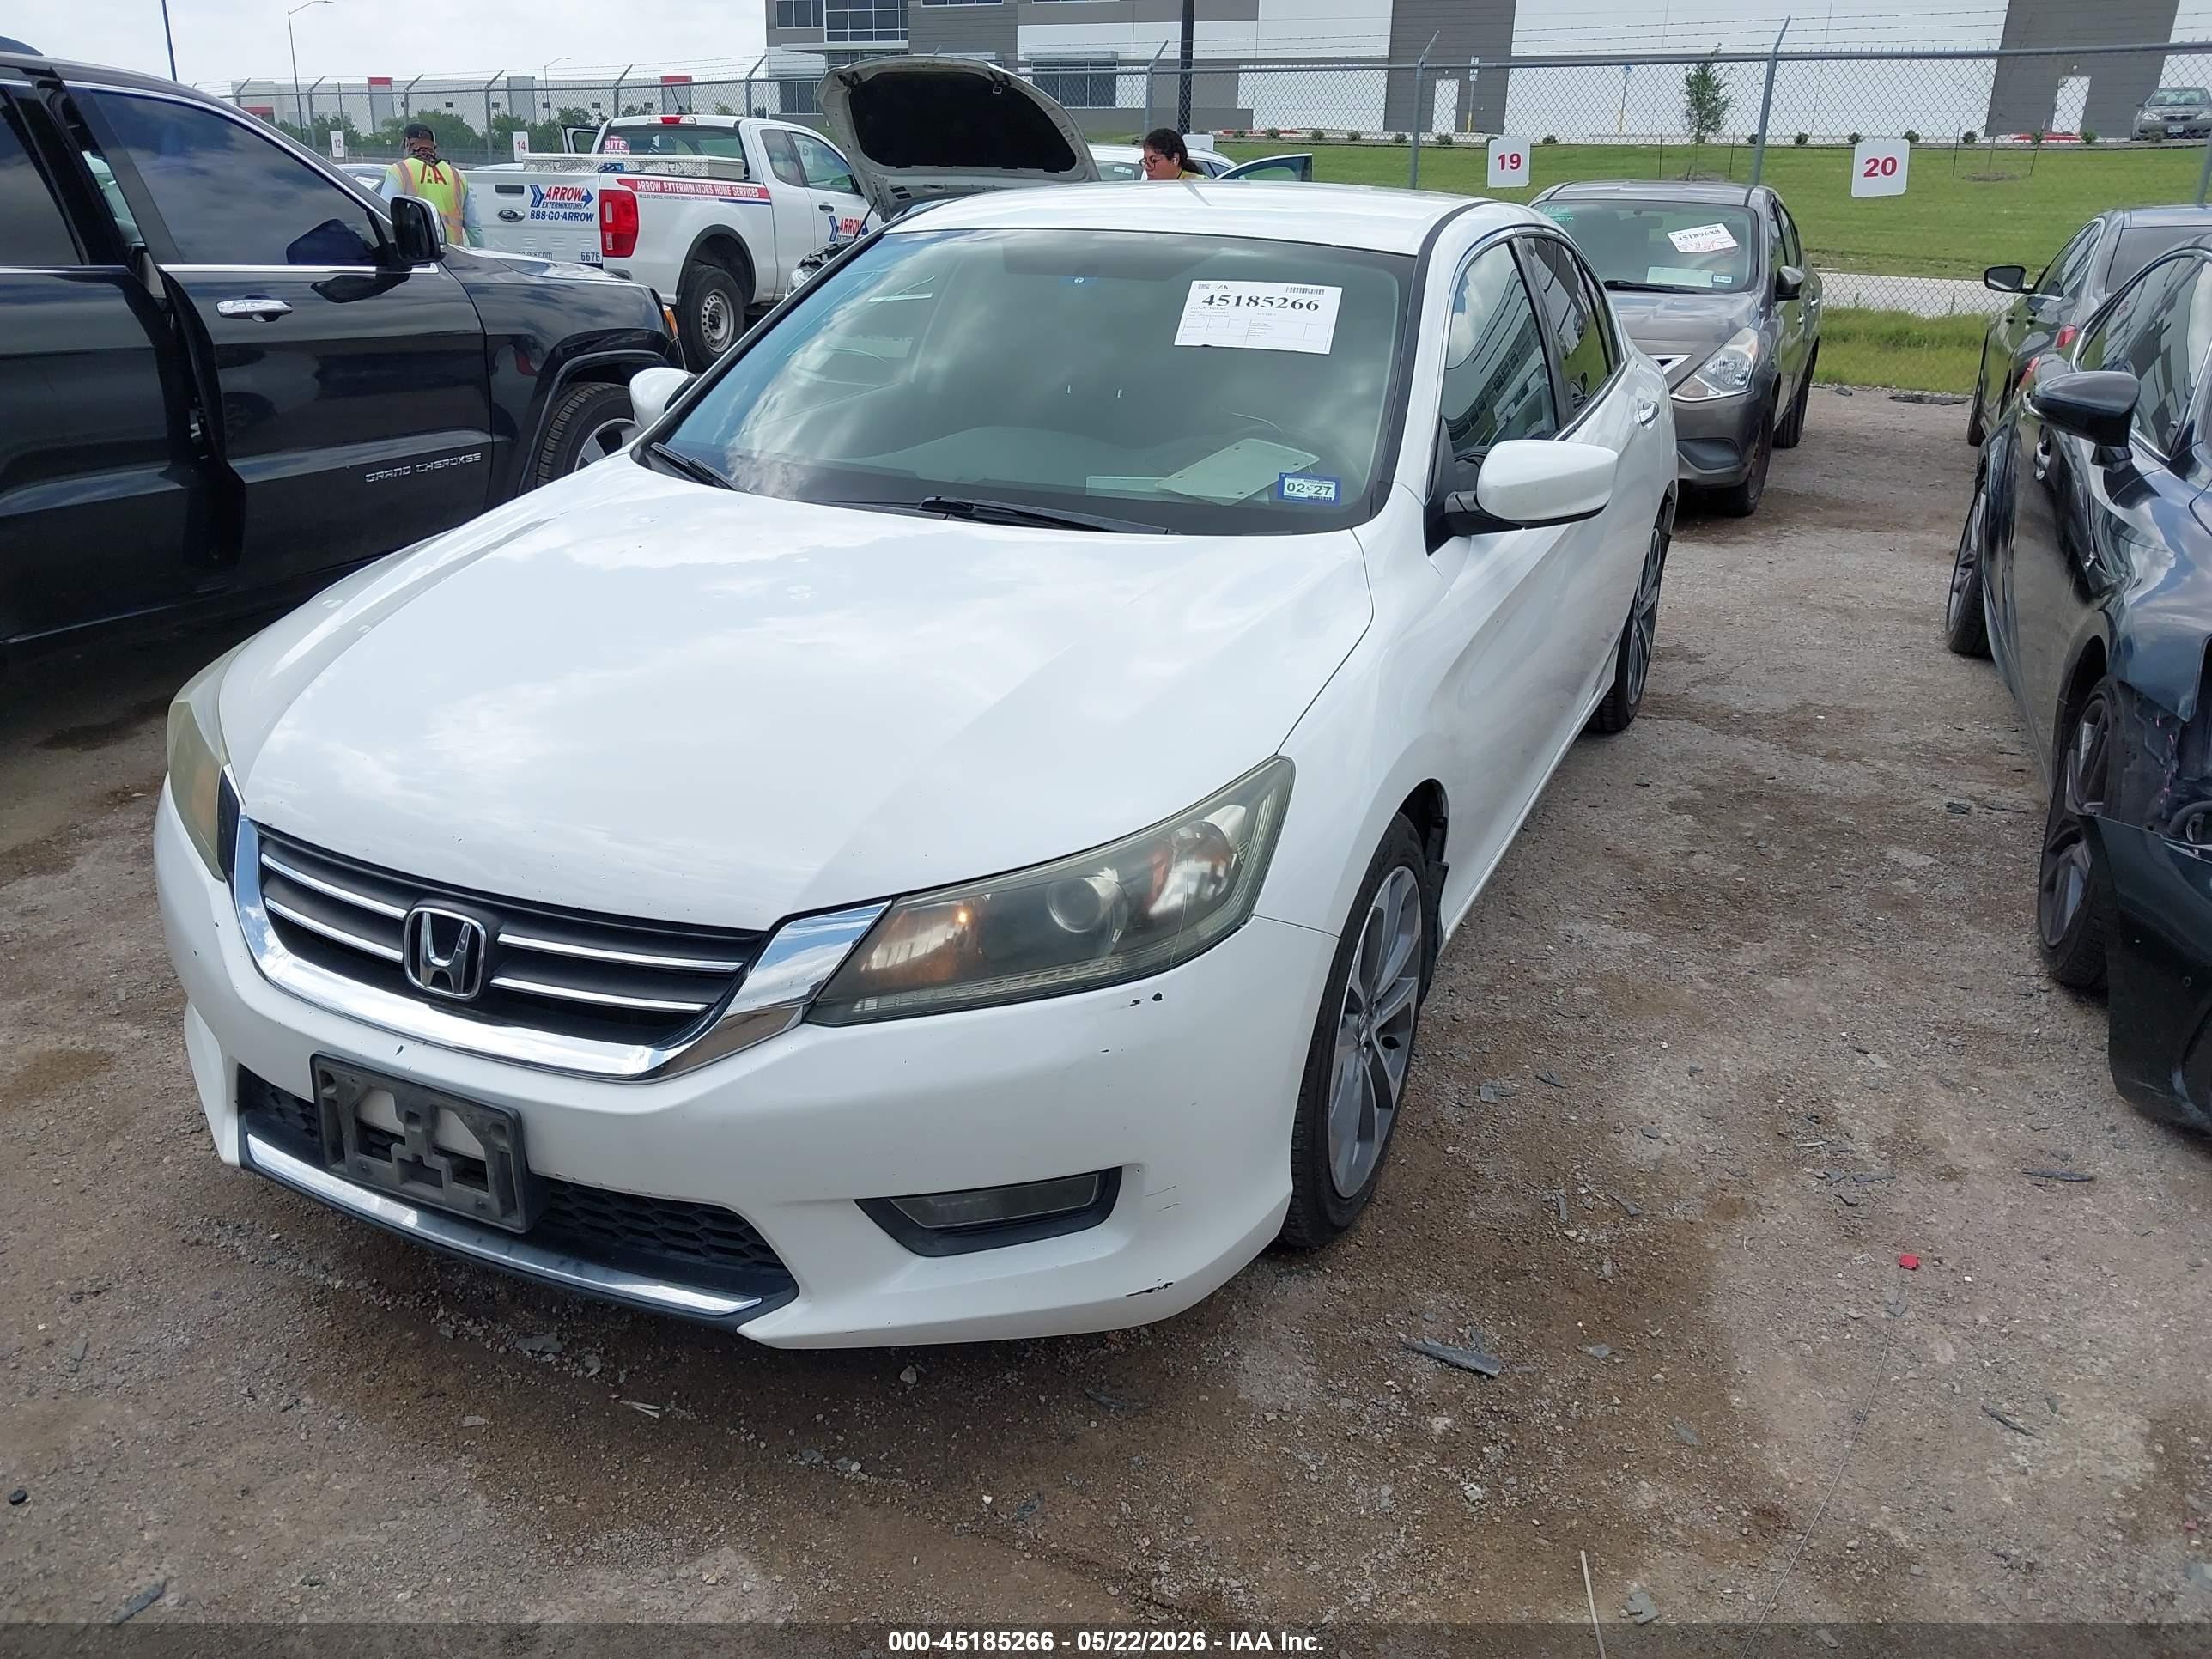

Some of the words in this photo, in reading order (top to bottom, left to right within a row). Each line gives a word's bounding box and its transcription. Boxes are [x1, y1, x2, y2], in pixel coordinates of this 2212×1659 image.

[334, 139, 342, 149] 12
[516, 140, 526, 152] 14
[605, 140, 627, 149] BITE
[1498, 153, 1522, 171] 19
[1863, 156, 1898, 178] 20
[544, 185, 584, 202] ARROW
[636, 179, 661, 192] ARROW
[664, 181, 714, 196] EXTERMINATORS
[714, 185, 732, 197] HOME
[732, 186, 760, 198] SERVICES
[542, 201, 584, 210] EXTERMINATORS
[1201, 294, 1320, 312] 45185266
[365, 465, 411, 483] GRAND
[416, 453, 482, 473] CHEROKEE
